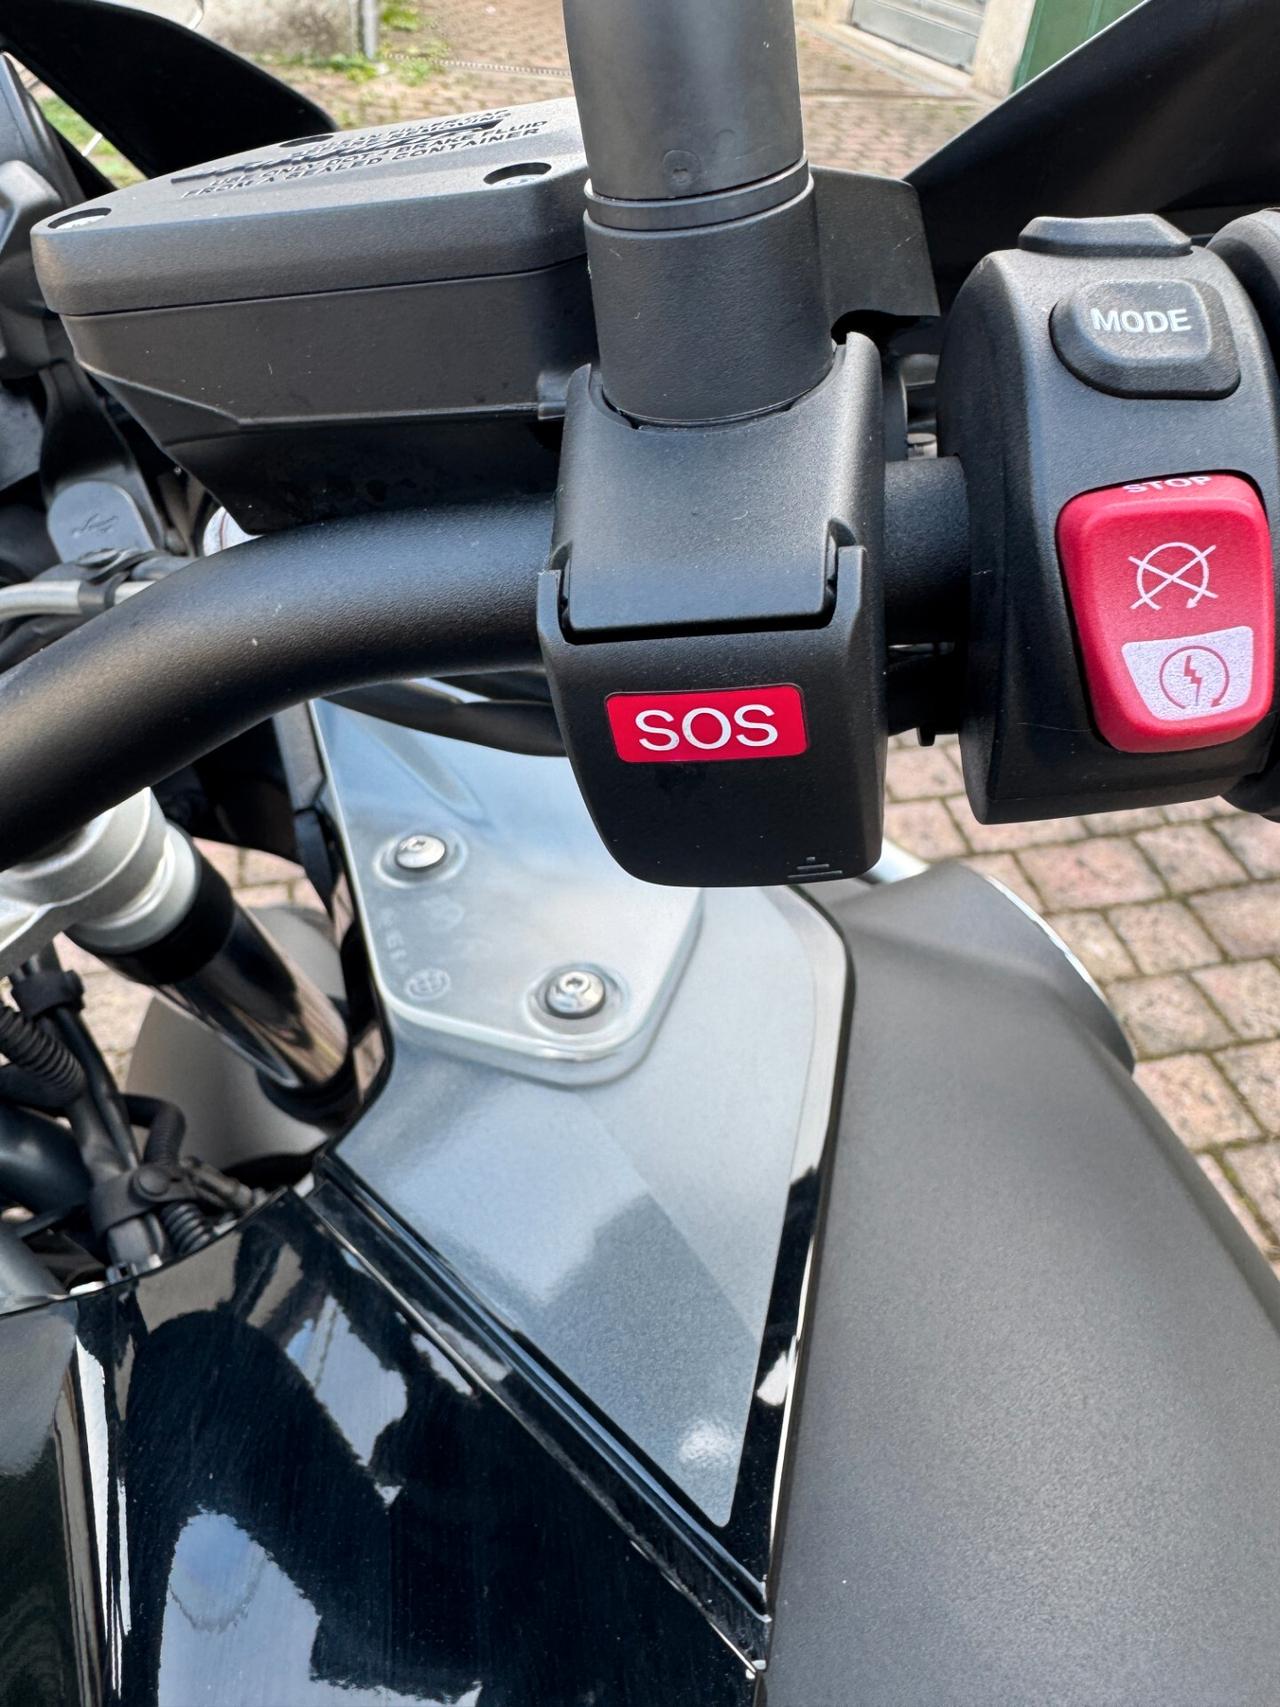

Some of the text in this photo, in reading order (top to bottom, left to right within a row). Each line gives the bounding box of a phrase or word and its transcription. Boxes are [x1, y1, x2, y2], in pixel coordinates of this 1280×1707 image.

[180, 180, 254, 198] FROM
[285, 157, 383, 180] SEALED
[391, 128, 540, 160] CONTAINER
[325, 153, 369, 166] DOT
[396, 134, 475, 153] BRAKE
[481, 121, 548, 137] FLUID
[1092, 308, 1192, 334] MODE
[1122, 475, 1213, 494] STOP
[634, 703, 779, 752] SOS
